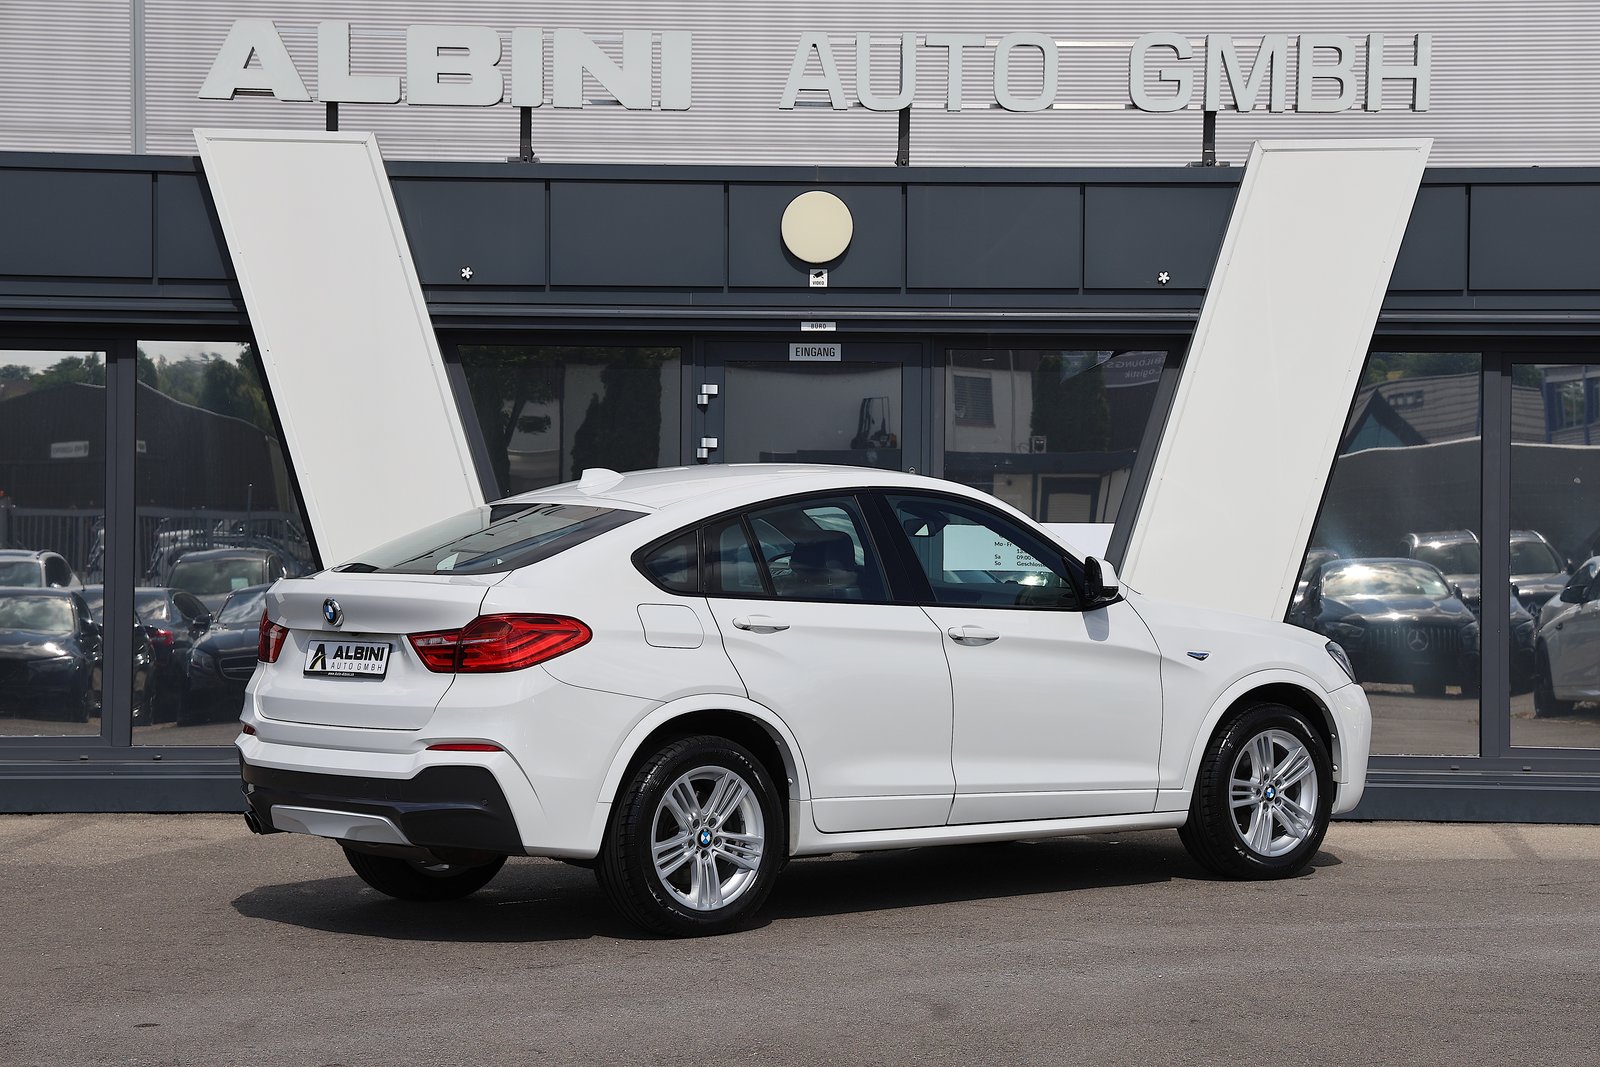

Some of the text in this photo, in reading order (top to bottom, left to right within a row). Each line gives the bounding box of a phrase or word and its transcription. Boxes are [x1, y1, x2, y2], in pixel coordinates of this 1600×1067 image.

[197, 19, 1433, 113] ALBINI AUTO GMBH
[795, 346, 836, 357] EINGANG
[333, 646, 385, 661] ALBINI
[331, 662, 382, 671] AUTO GMBH
